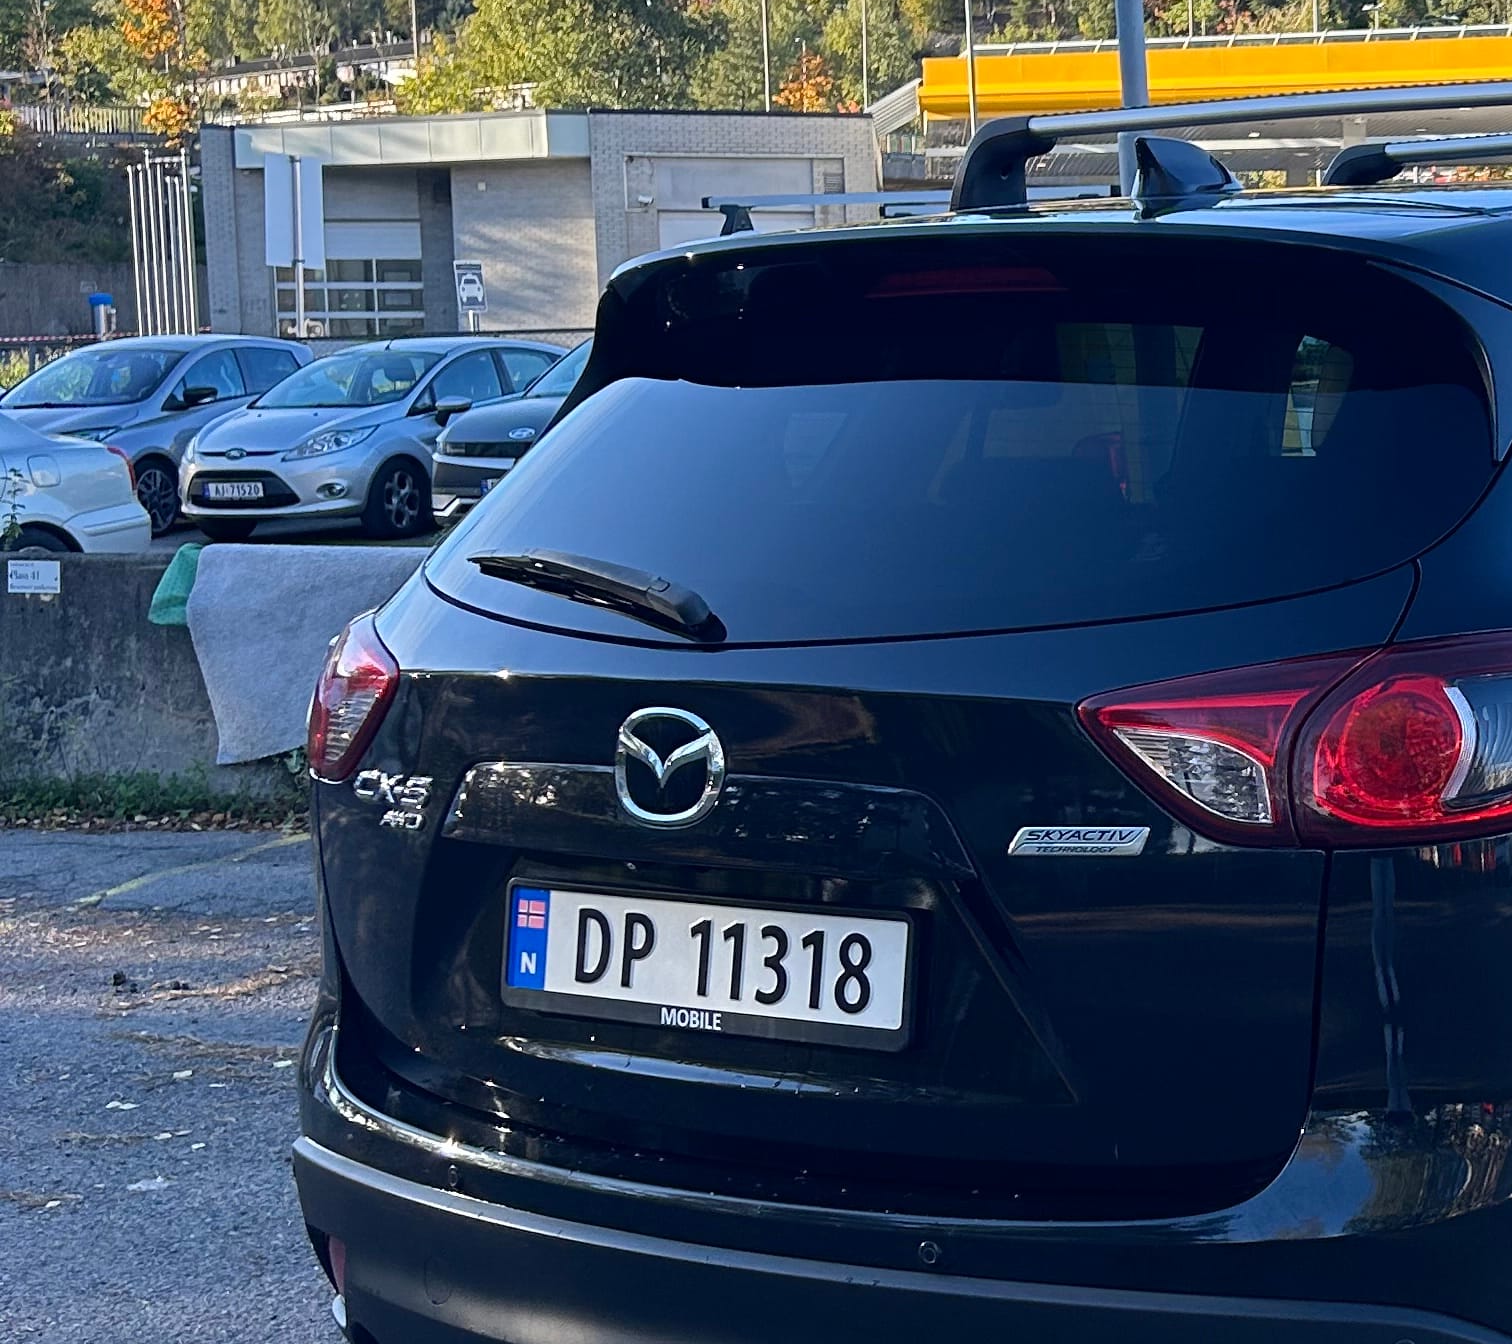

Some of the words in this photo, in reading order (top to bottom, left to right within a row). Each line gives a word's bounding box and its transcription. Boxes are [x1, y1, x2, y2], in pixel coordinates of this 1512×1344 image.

[353, 769, 434, 810] CX-5
[1025, 830, 1135, 841] SKYACTIV
[519, 952, 537, 975] N
[574, 907, 656, 988] DP
[690, 919, 873, 1014] 11318
[660, 1007, 722, 1031] MOBILE
